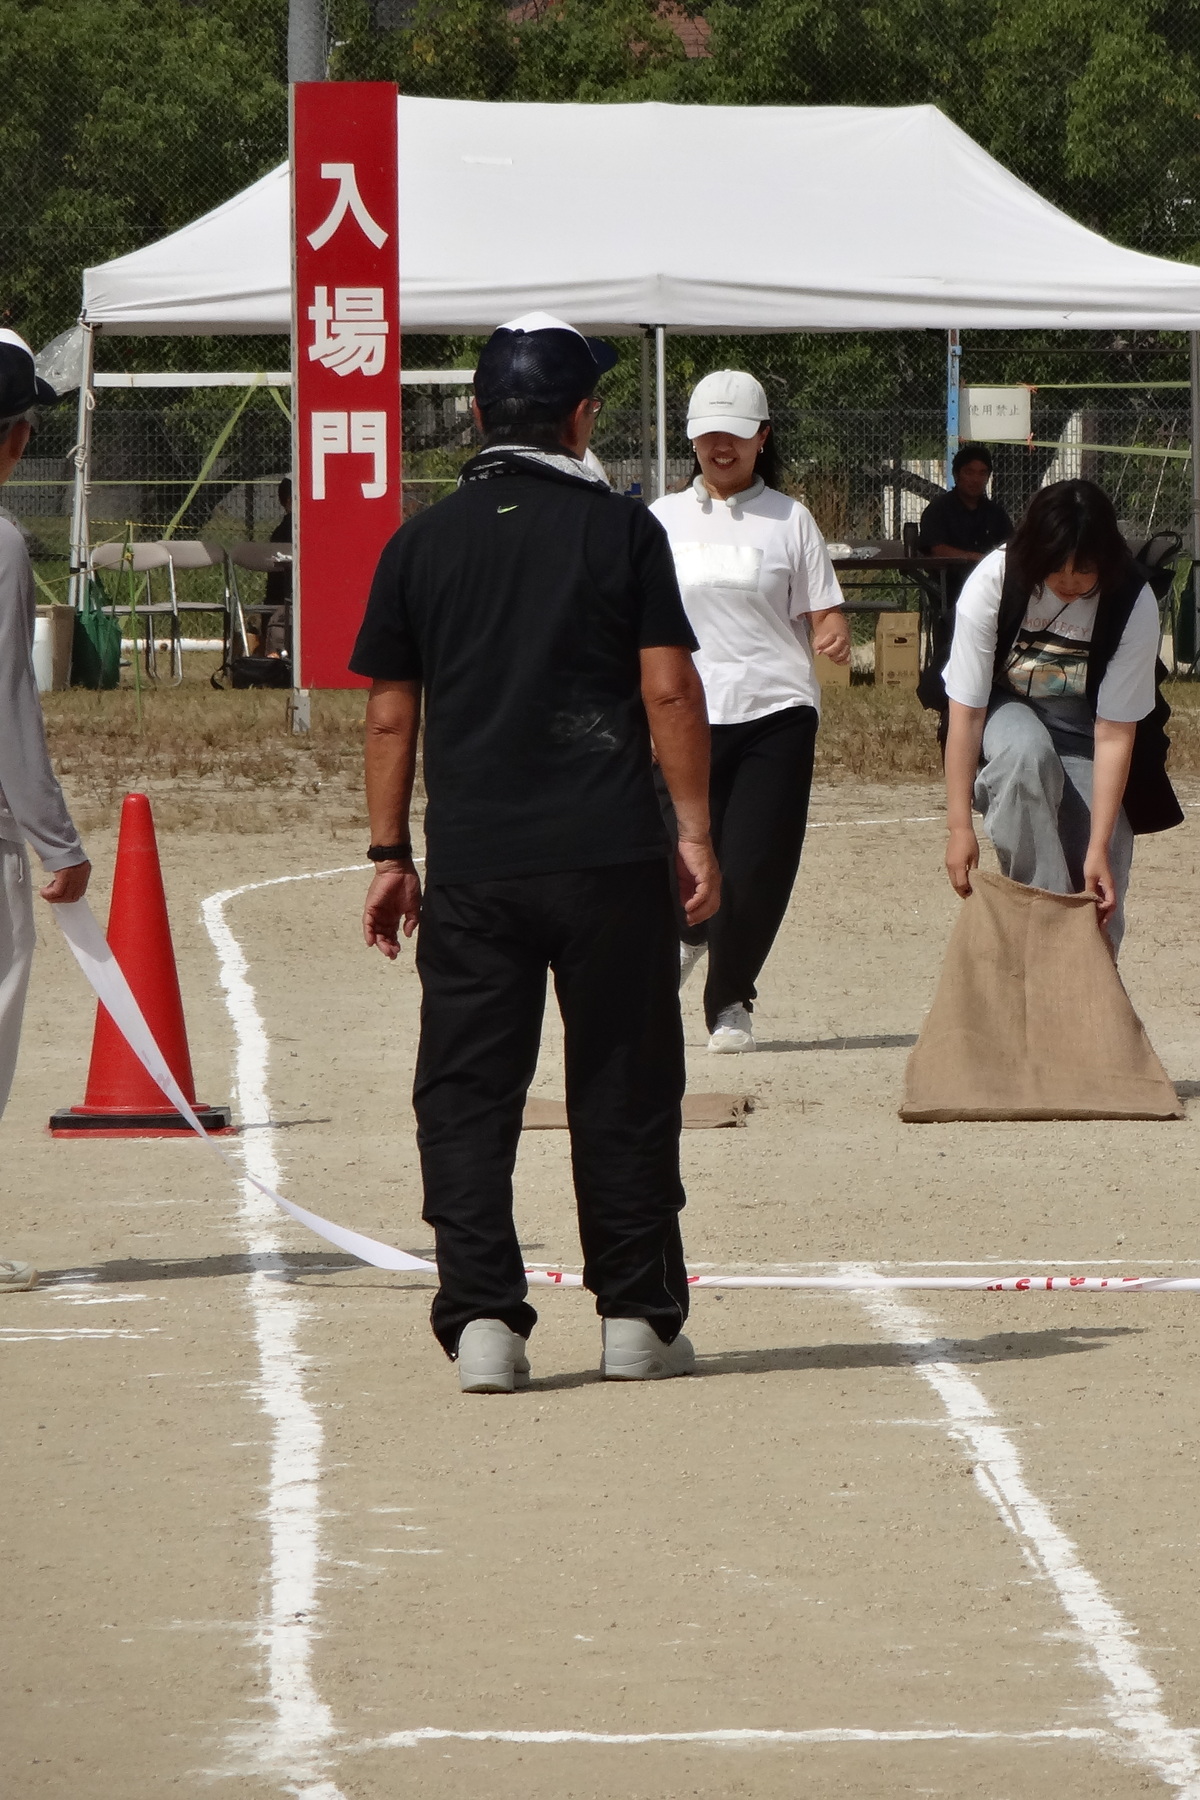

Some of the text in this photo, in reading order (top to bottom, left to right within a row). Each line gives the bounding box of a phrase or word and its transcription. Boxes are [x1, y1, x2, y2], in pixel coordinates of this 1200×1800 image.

[307, 162, 389, 500] 入場門
[968, 404, 1020, 417] 使用禁止
